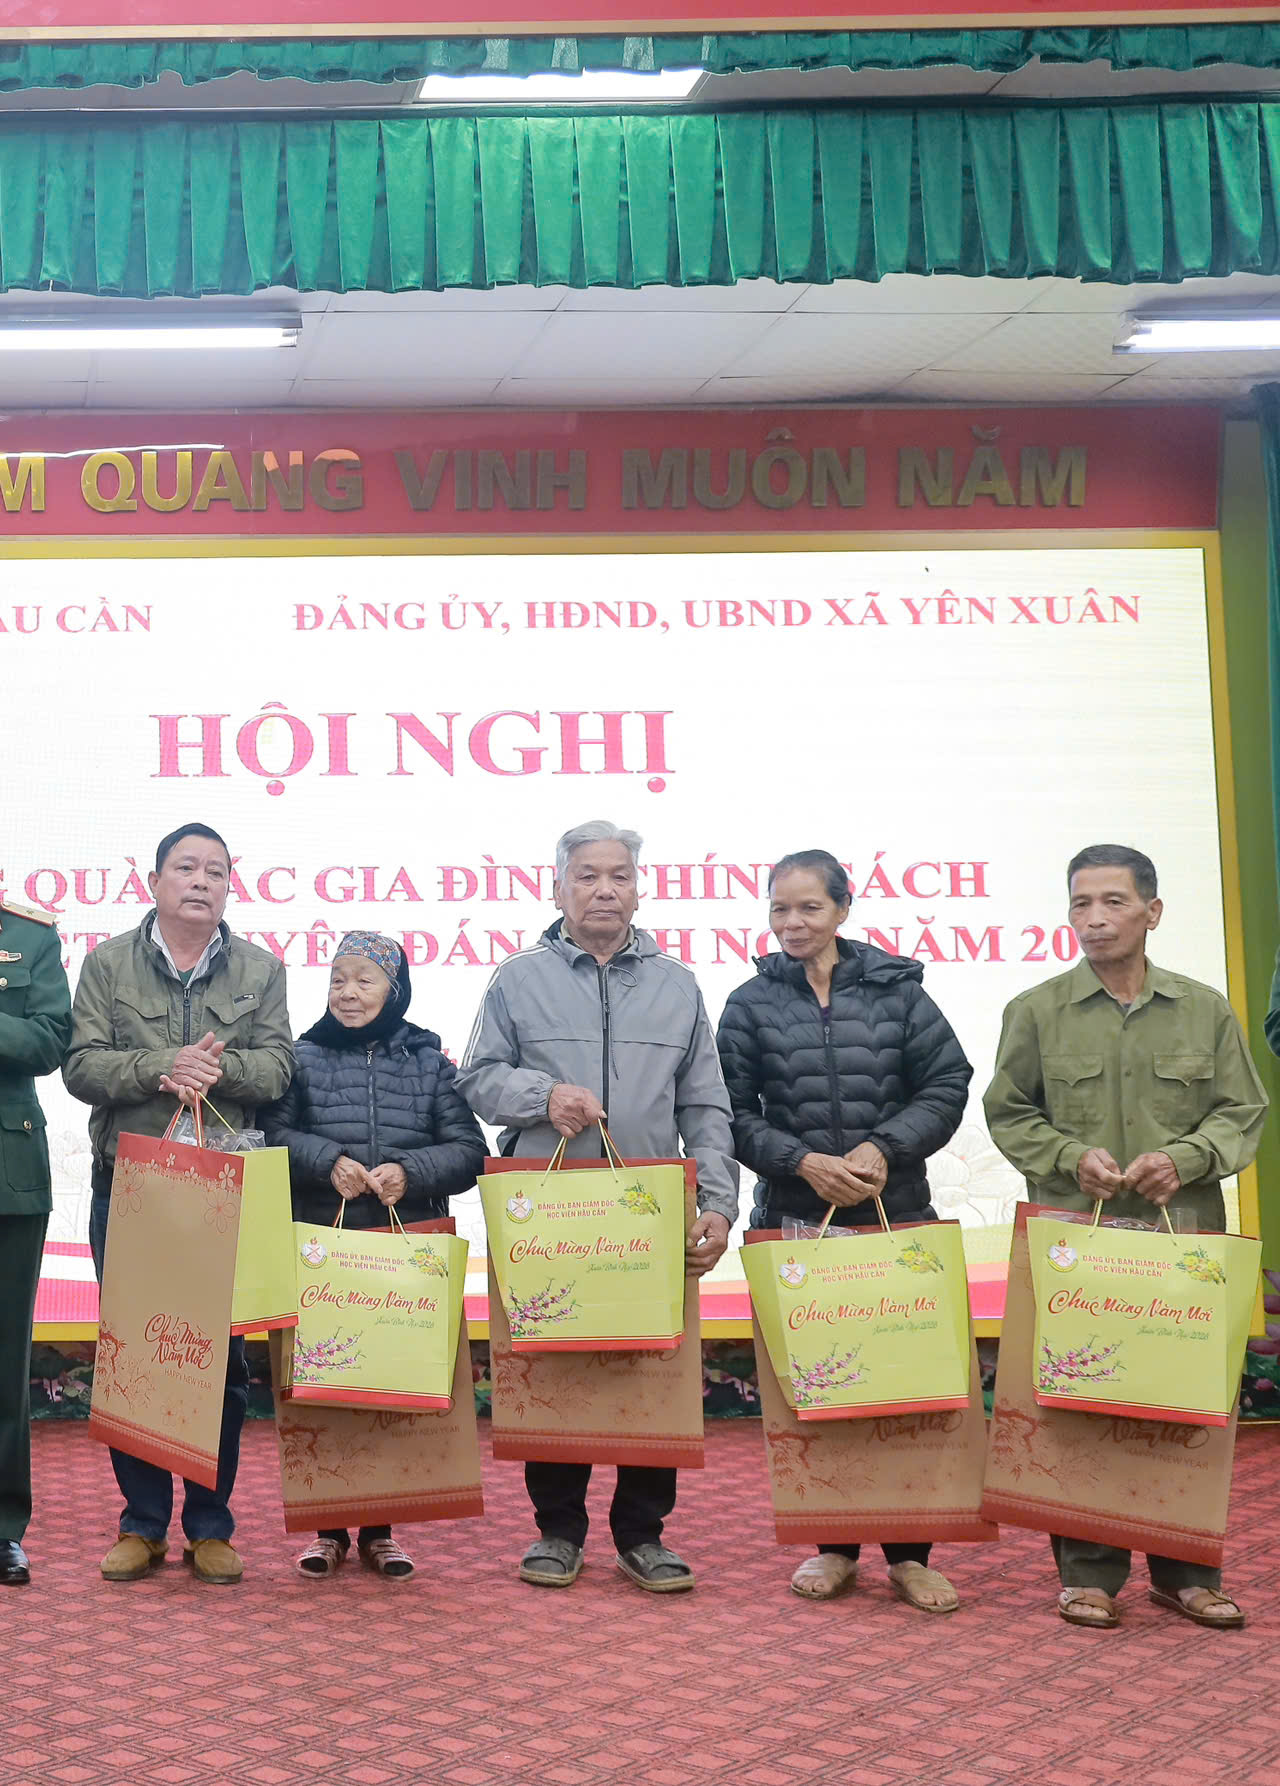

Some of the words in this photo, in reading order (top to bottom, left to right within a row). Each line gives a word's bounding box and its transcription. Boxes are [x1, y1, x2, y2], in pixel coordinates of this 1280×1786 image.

[80, 448, 364, 513] QUANG
[395, 448, 587, 511] VINH
[622, 427, 866, 510] MUÔN
[897, 425, 1088, 508] NĂM
[56, 597, 153, 633] CẦN
[292, 594, 425, 631] ĐẢNG
[439, 594, 512, 635] ỦY,
[525, 600, 670, 633] HĐND,
[683, 598, 813, 629] UBND
[823, 592, 889, 627] XÃ
[901, 589, 997, 625] YÊN
[1008, 588, 1142, 625] XUÂN
[150, 702, 358, 797] HỘI
[387, 709, 676, 793] NGHỊ
[24, 857, 156, 913] QUÀ
[228, 856, 296, 904] ÁC
[314, 866, 425, 903] GIA
[437, 855, 557, 902] ĐÌN
[638, 852, 774, 900] HÍN
[861, 916, 1007, 963] NĂM
[1021, 924, 1079, 963] 20
